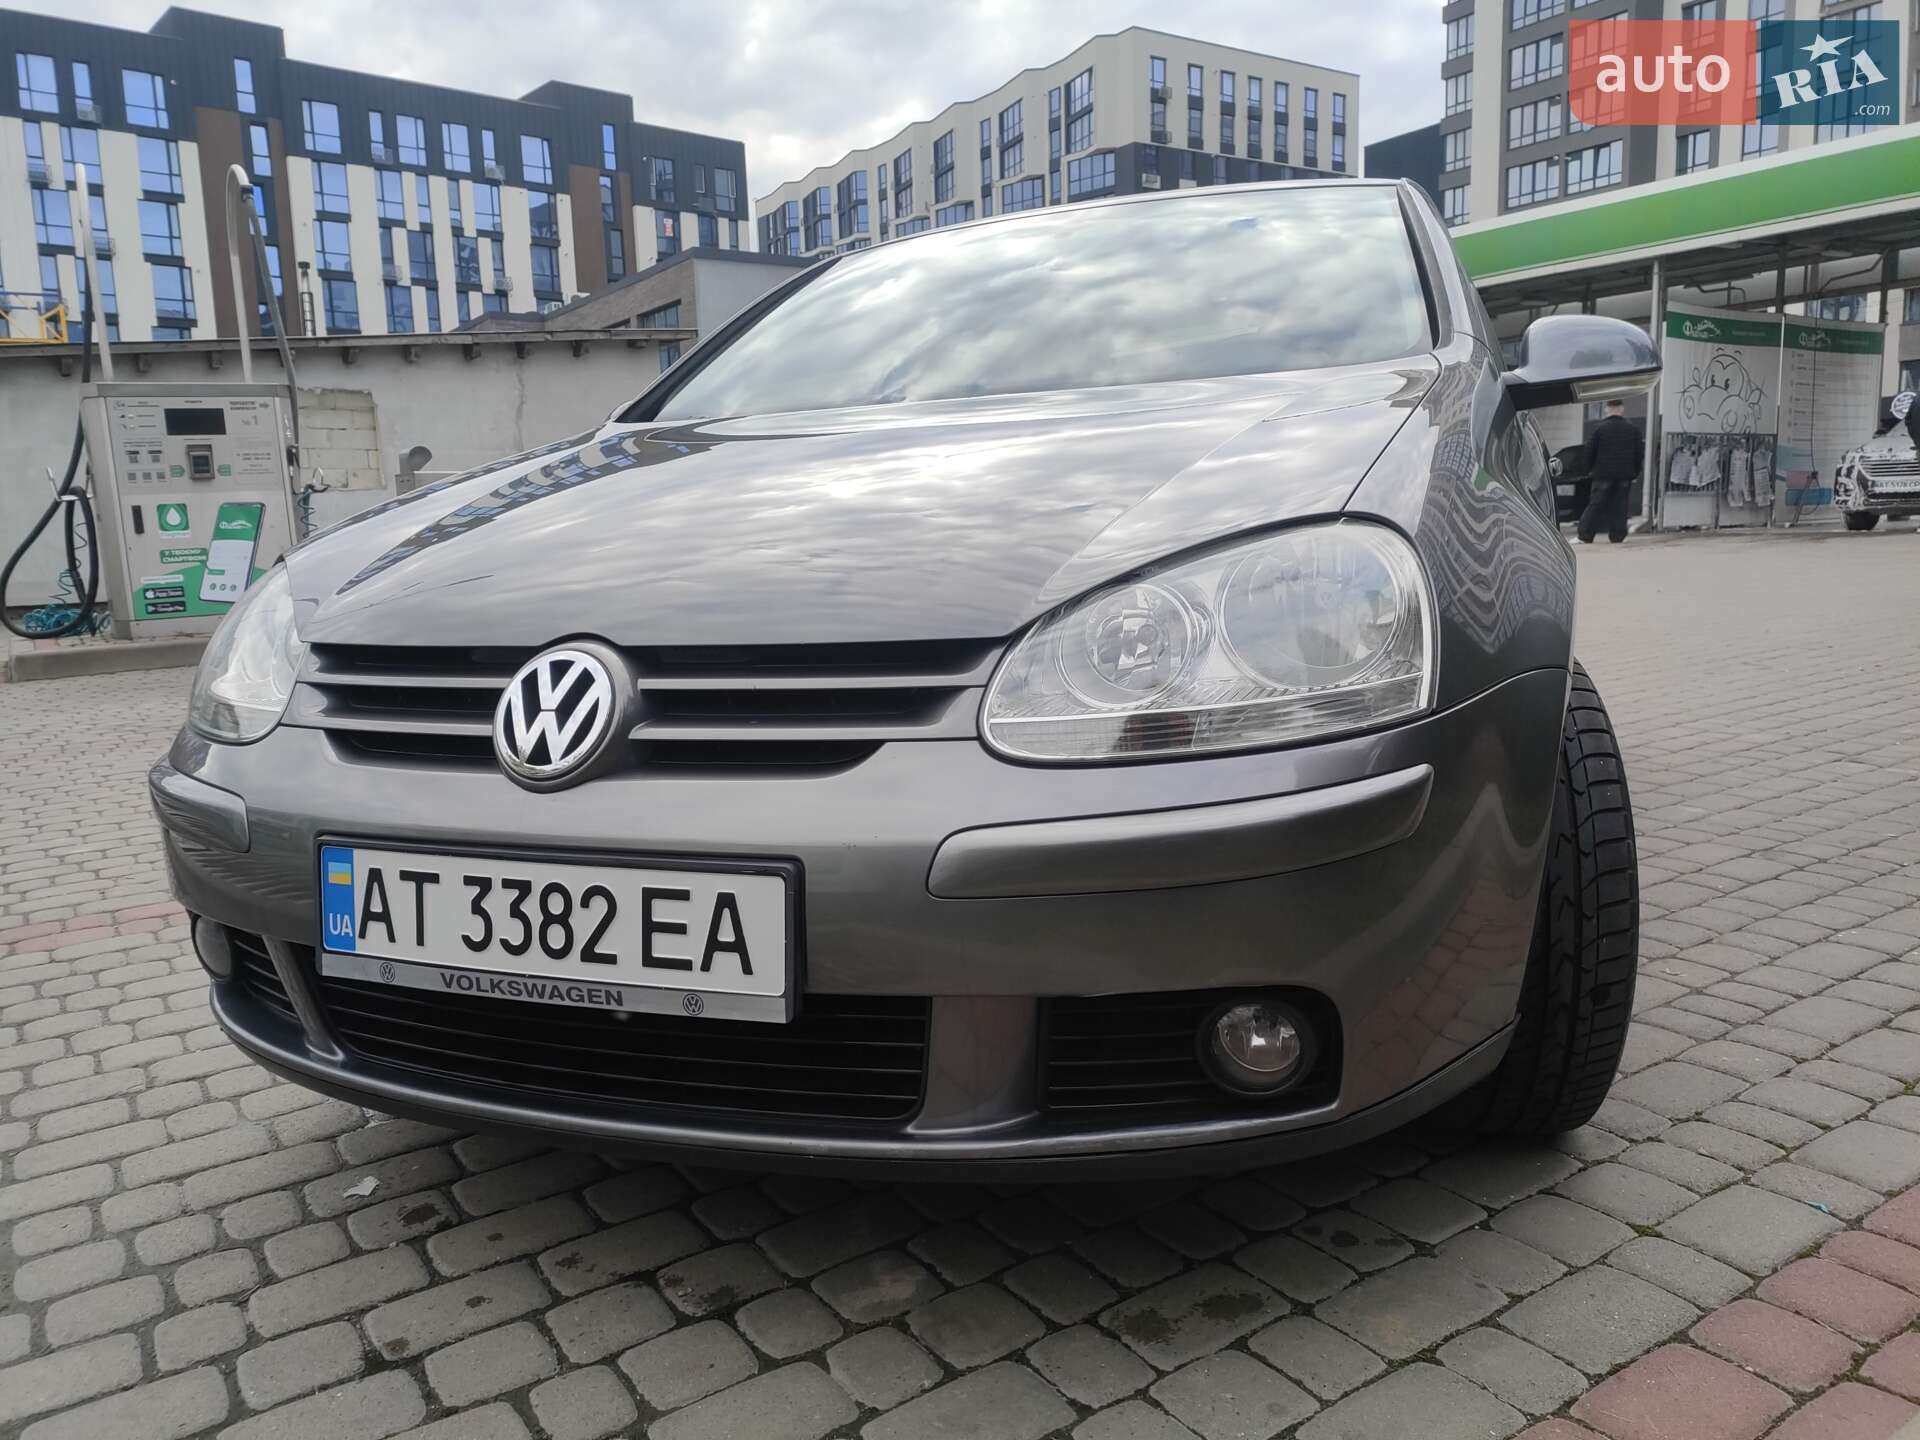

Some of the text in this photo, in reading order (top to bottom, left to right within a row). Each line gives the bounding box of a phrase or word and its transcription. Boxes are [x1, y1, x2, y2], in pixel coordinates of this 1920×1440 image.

[329, 913, 354, 938] UA
[358, 867, 754, 976] AT 3382 EA
[439, 972, 624, 1008] VOLKSWAGEN
